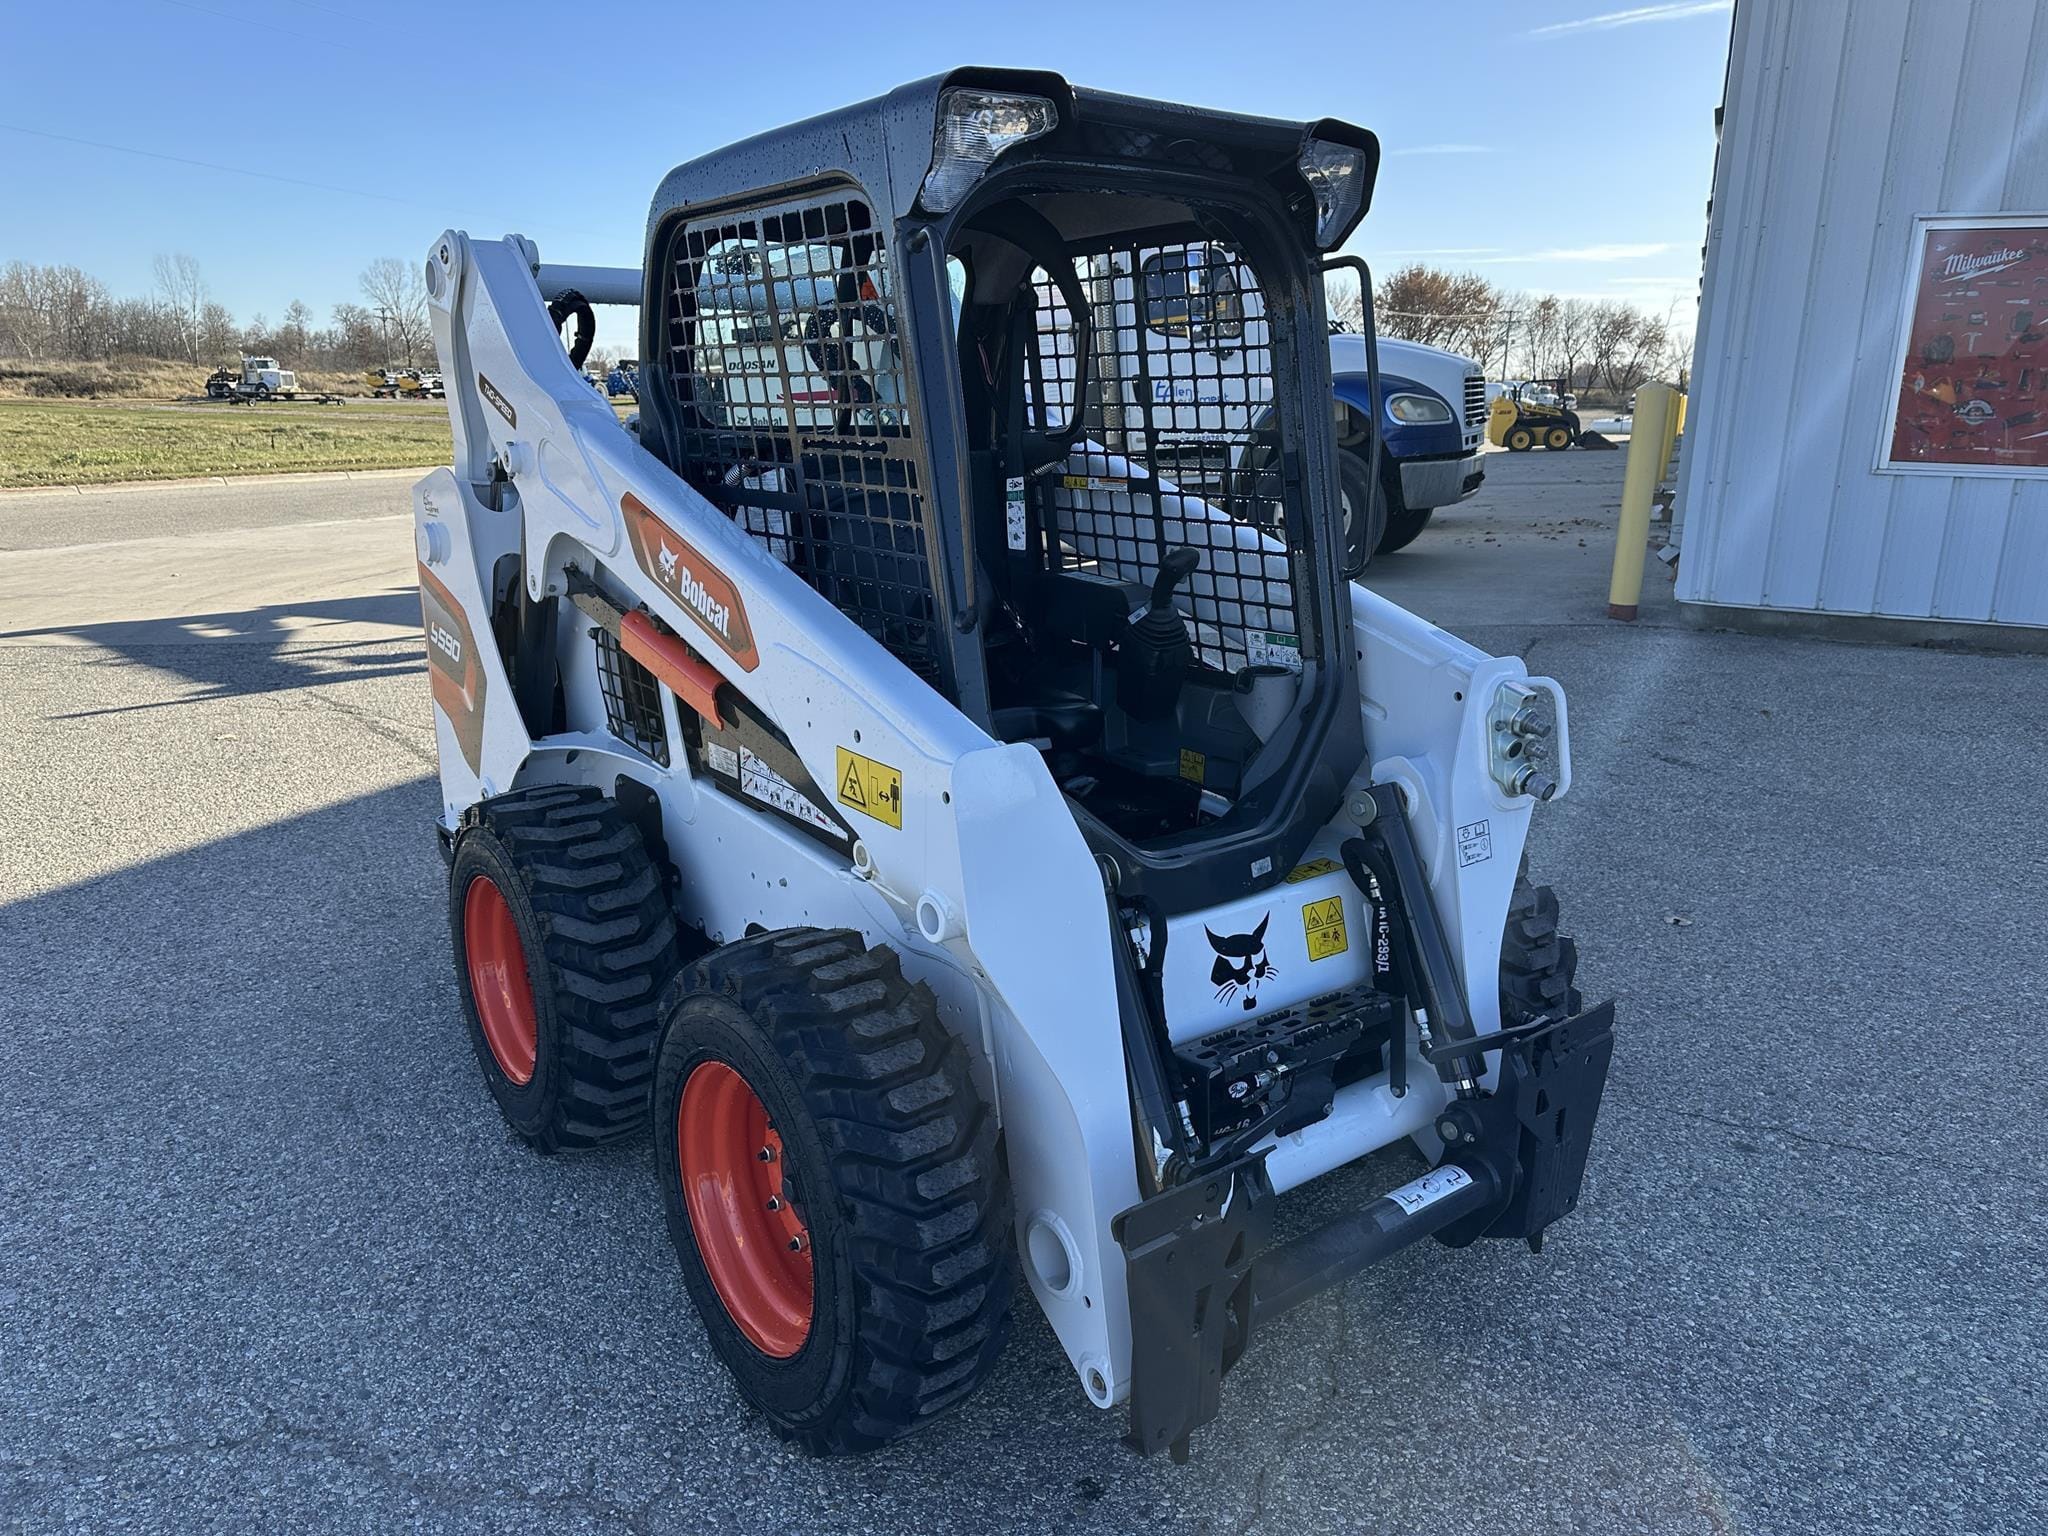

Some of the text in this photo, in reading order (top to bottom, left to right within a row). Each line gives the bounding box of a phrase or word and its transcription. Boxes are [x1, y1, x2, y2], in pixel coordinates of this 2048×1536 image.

[1943, 248, 2025, 275] Milwaukee
[681, 566, 730, 638] Bobcat
[430, 620, 461, 663] S590
